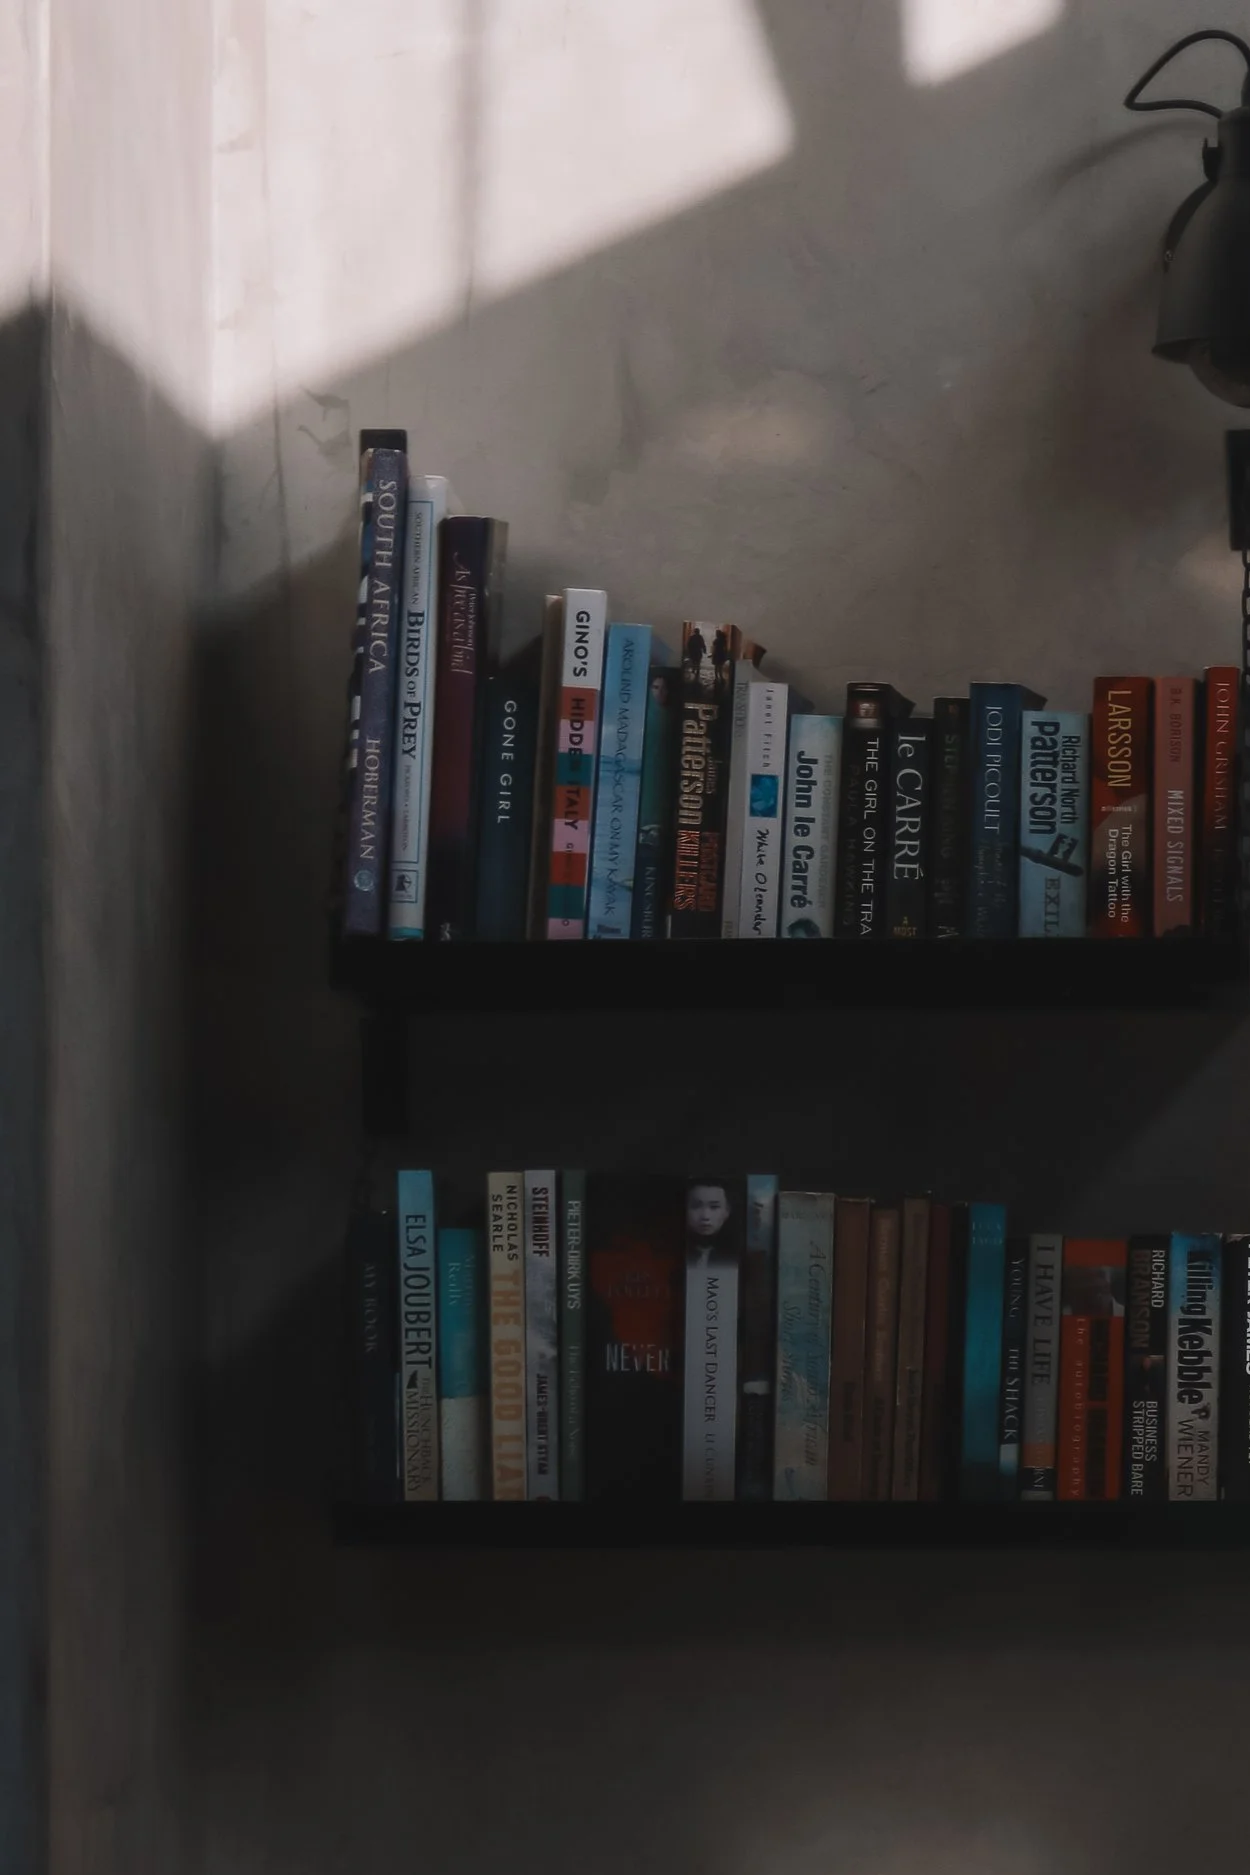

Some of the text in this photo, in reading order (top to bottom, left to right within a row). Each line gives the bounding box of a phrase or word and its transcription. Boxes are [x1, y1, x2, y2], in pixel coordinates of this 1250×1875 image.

[367, 479, 397, 674] SOUTH AFRICA
[405, 610, 425, 679] BIRDS
[573, 610, 590, 678] GINO'S
[406, 681, 417, 698] OF
[985, 706, 1003, 746] JODI
[1215, 682, 1231, 738] JOHN
[402, 701, 421, 760] PREY
[497, 699, 518, 824] GONE GIRL
[678, 702, 720, 825] Patterson
[762, 734, 777, 768] Fitch
[1107, 689, 1132, 788] LARSSON
[359, 739, 381, 859] HOBERMAN
[564, 780, 581, 830] ITALY
[603, 638, 635, 916] AROUND MADAGASCAR ON MY KAYAK
[893, 732, 927, 880] le CARRÉ
[983, 754, 1002, 835] PICOULT
[1029, 720, 1061, 835] Patterson
[1060, 735, 1081, 824] Richard North
[1213, 741, 1229, 830] GRISHAM
[790, 750, 819, 908] John le Carré
[859, 737, 880, 936] THE GIRL ON THE TRA
[1165, 788, 1185, 903] MIXED SIGNALS
[673, 829, 700, 911] KILLERS
[752, 829, 770, 935] White Oleander
[1044, 876, 1061, 938] EXIL
[1105, 828, 1119, 919] Dragon Tattoo
[1120, 824, 1132, 923] The Girl with the
[492, 1194, 504, 1252] SEARLE
[506, 1184, 519, 1262] NICHOLAS
[532, 1186, 550, 1258] STEINHOFF
[567, 1199, 584, 1310] PIETER-DIRK UYS
[403, 1214, 433, 1369] ELSA JOUBERT
[705, 1276, 720, 1322] MAO'S
[807, 1263, 827, 1327] Century
[1008, 1257, 1026, 1318] YOUNG
[1033, 1264, 1054, 1327] HAVE
[1129, 1249, 1151, 1348] BRANSON
[1151, 1249, 1165, 1309] RICHARD
[493, 1268, 523, 1421] THE GOOD
[605, 1342, 671, 1373] NEVER
[705, 1326, 719, 1358] LAST
[1031, 1338, 1052, 1385] LIFE
[704, 1363, 719, 1423] DANCER
[1003, 1376, 1021, 1440] SHACK
[1069, 1317, 1087, 1497] the autobiography
[1144, 1400, 1158, 1463] BUSINESS
[406, 1391, 422, 1492] MISSIONARY
[1130, 1400, 1145, 1497] STRIPPED BARE
[1176, 1419, 1195, 1497] WIENER
[1197, 1431, 1211, 1486] MANDY
